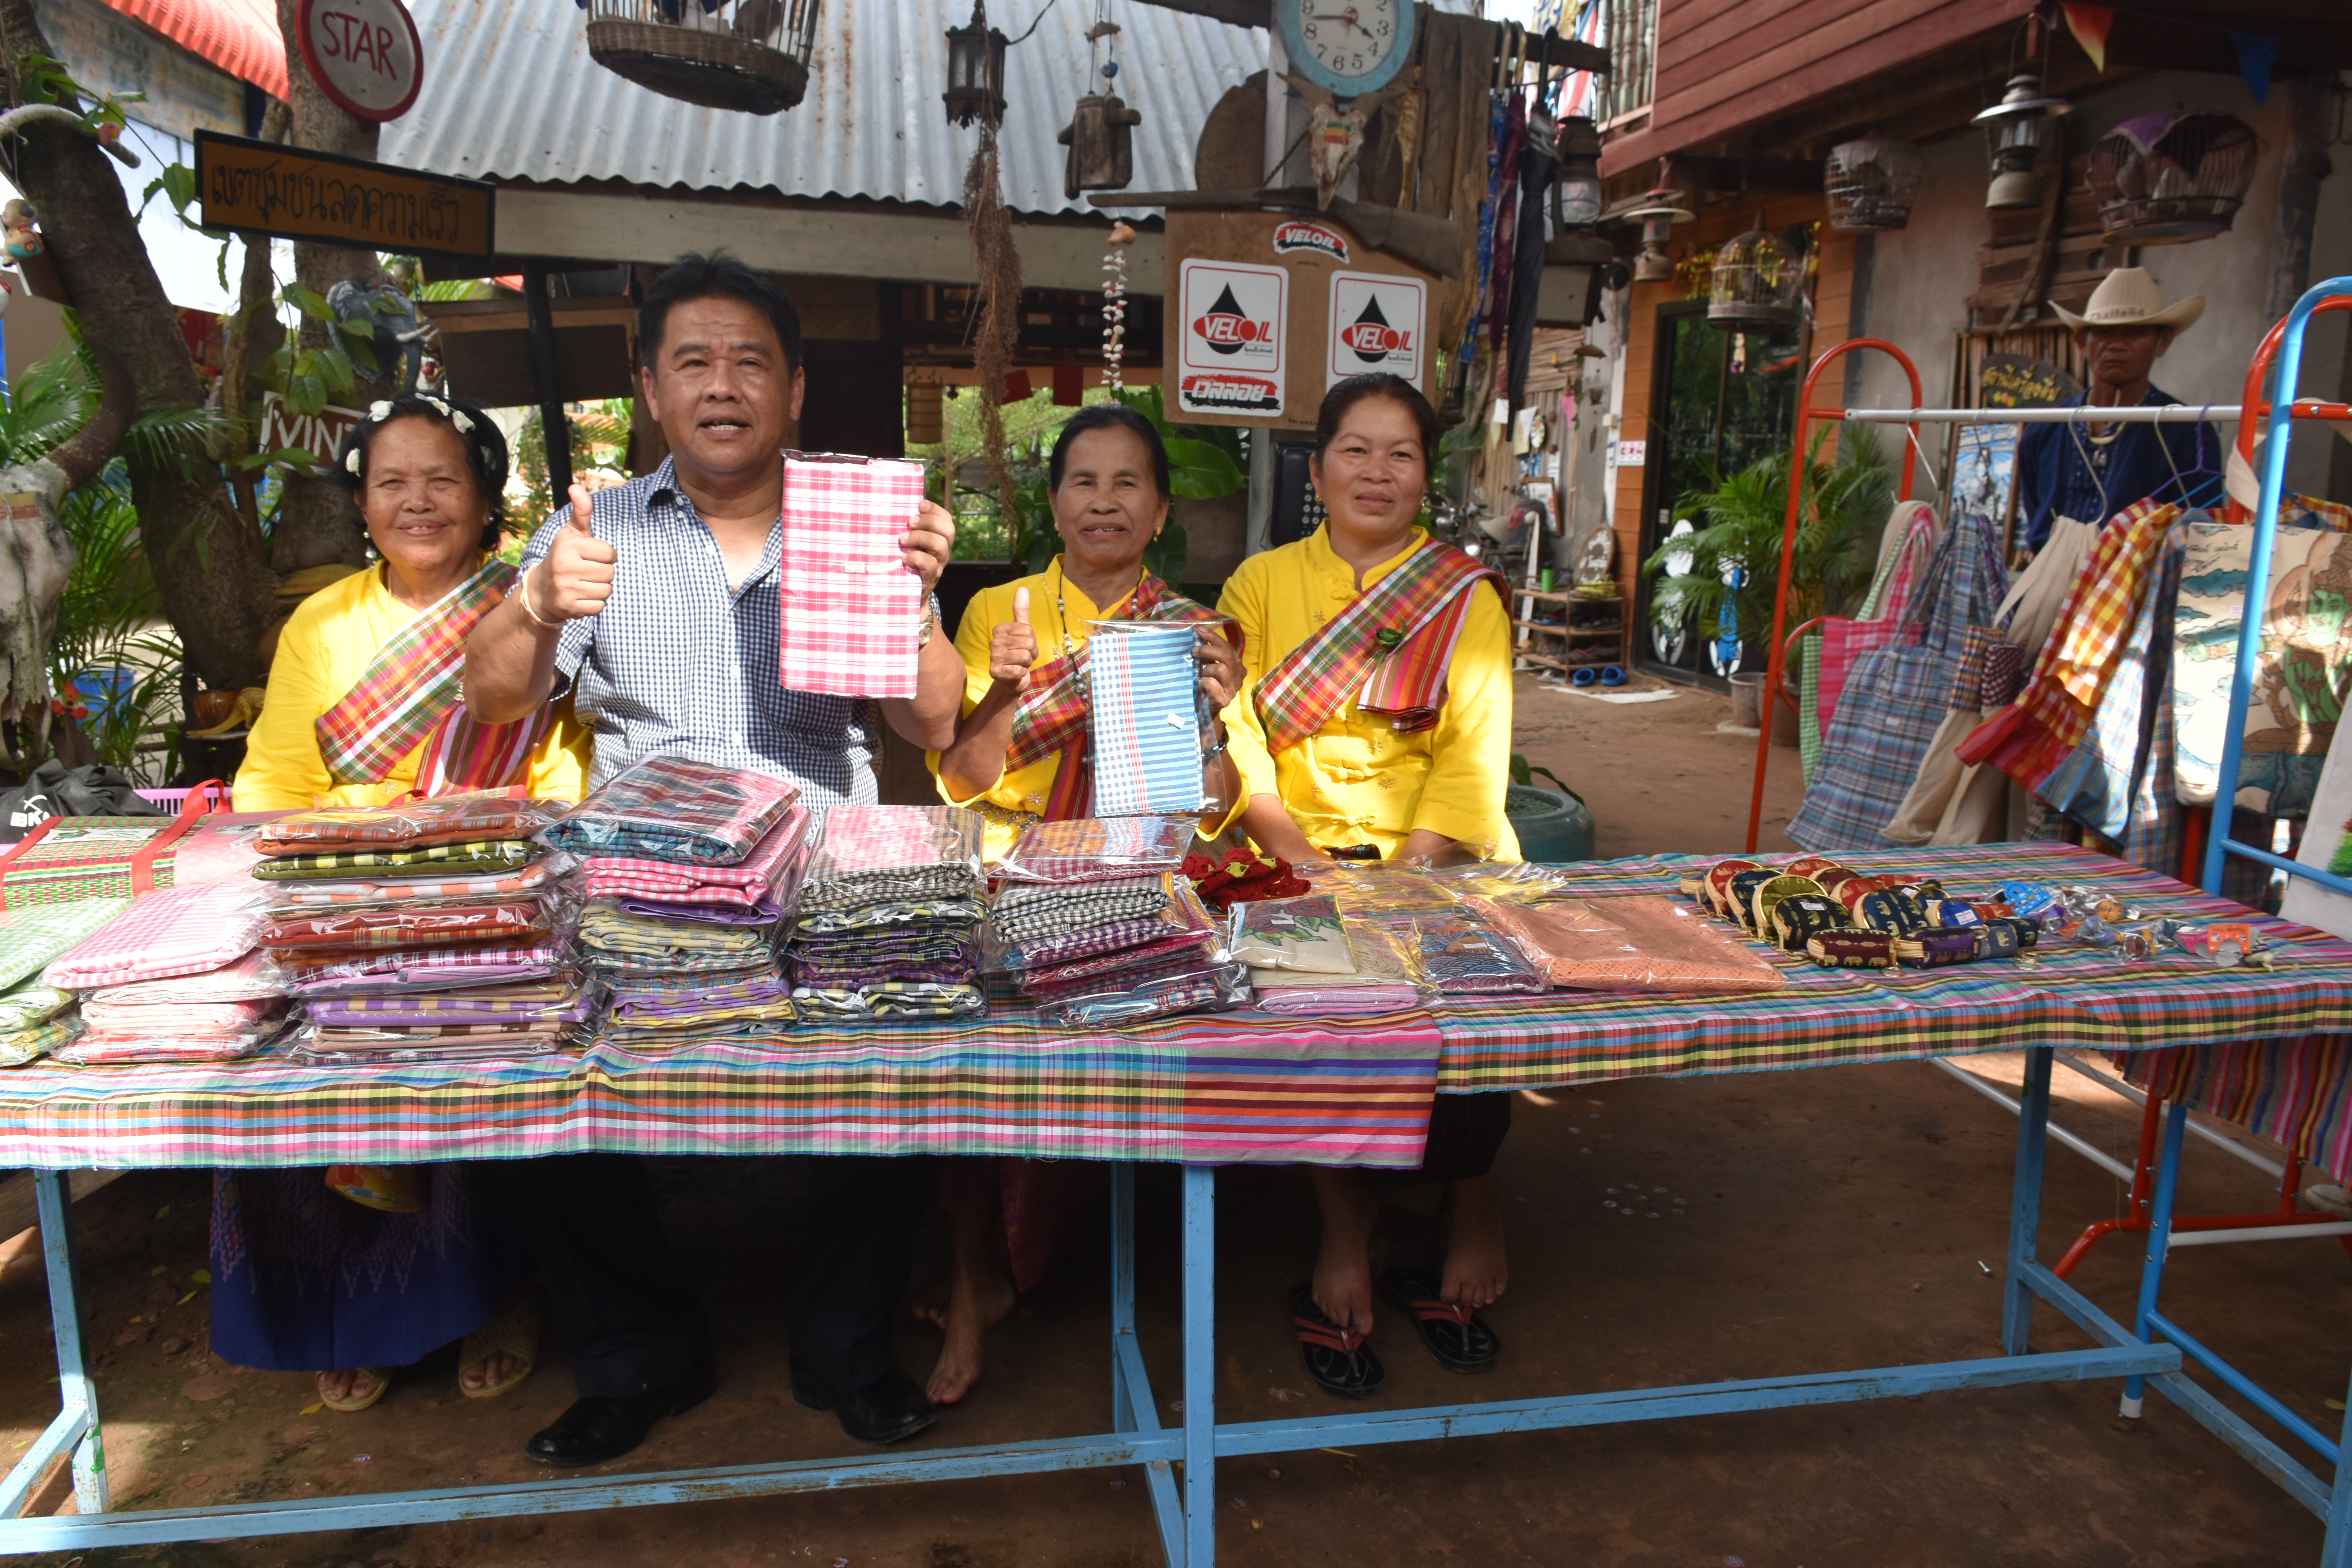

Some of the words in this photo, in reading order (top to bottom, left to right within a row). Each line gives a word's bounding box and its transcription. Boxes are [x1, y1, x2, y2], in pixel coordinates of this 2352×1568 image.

[1302, 0, 1314, 15] 9
[1304, 22, 1317, 40] 8
[1377, 20, 1389, 36] 3
[321, 11, 397, 80] STAR
[1317, 43, 1327, 59] 7
[1368, 41, 1378, 56] 4
[1333, 55, 1344, 71] 6
[1352, 53, 1363, 70] 5
[212, 160, 459, 243] เขตชุมชนลดความเร็ว
[1286, 228, 1336, 250] VELOIL
[1204, 315, 1273, 343] VELOIL
[1352, 326, 1413, 351] VELOIL
[1191, 379, 1269, 402] เวลลอย
[274, 409, 355, 462] VIN
